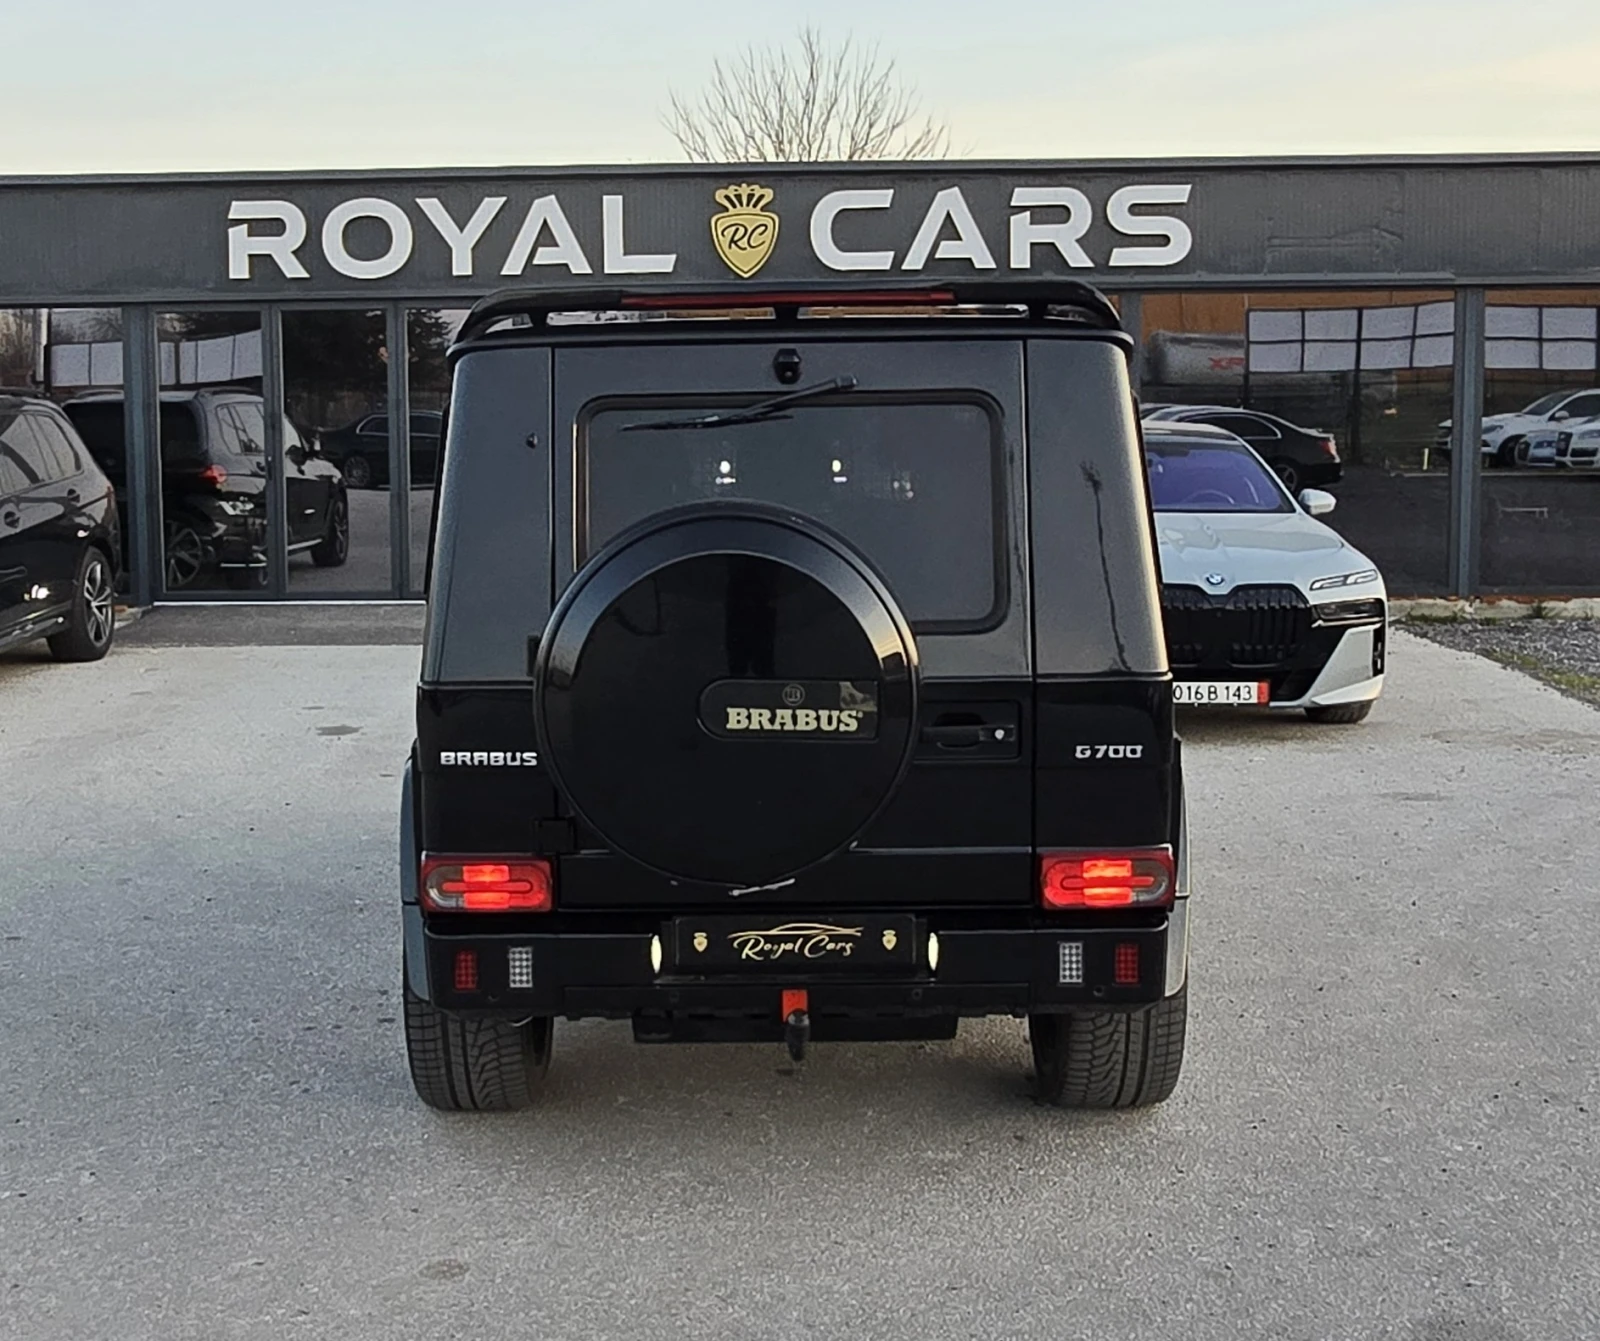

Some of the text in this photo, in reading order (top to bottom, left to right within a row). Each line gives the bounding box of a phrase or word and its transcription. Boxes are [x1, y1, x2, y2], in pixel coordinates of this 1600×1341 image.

[227, 184, 1193, 279] ROYAL CARS
[721, 223, 769, 251] RC
[1173, 684, 1204, 701] 016
[1225, 685, 1252, 701] 143
[440, 751, 538, 766] BRABUS
[733, 934, 855, 960] Royal Cars
